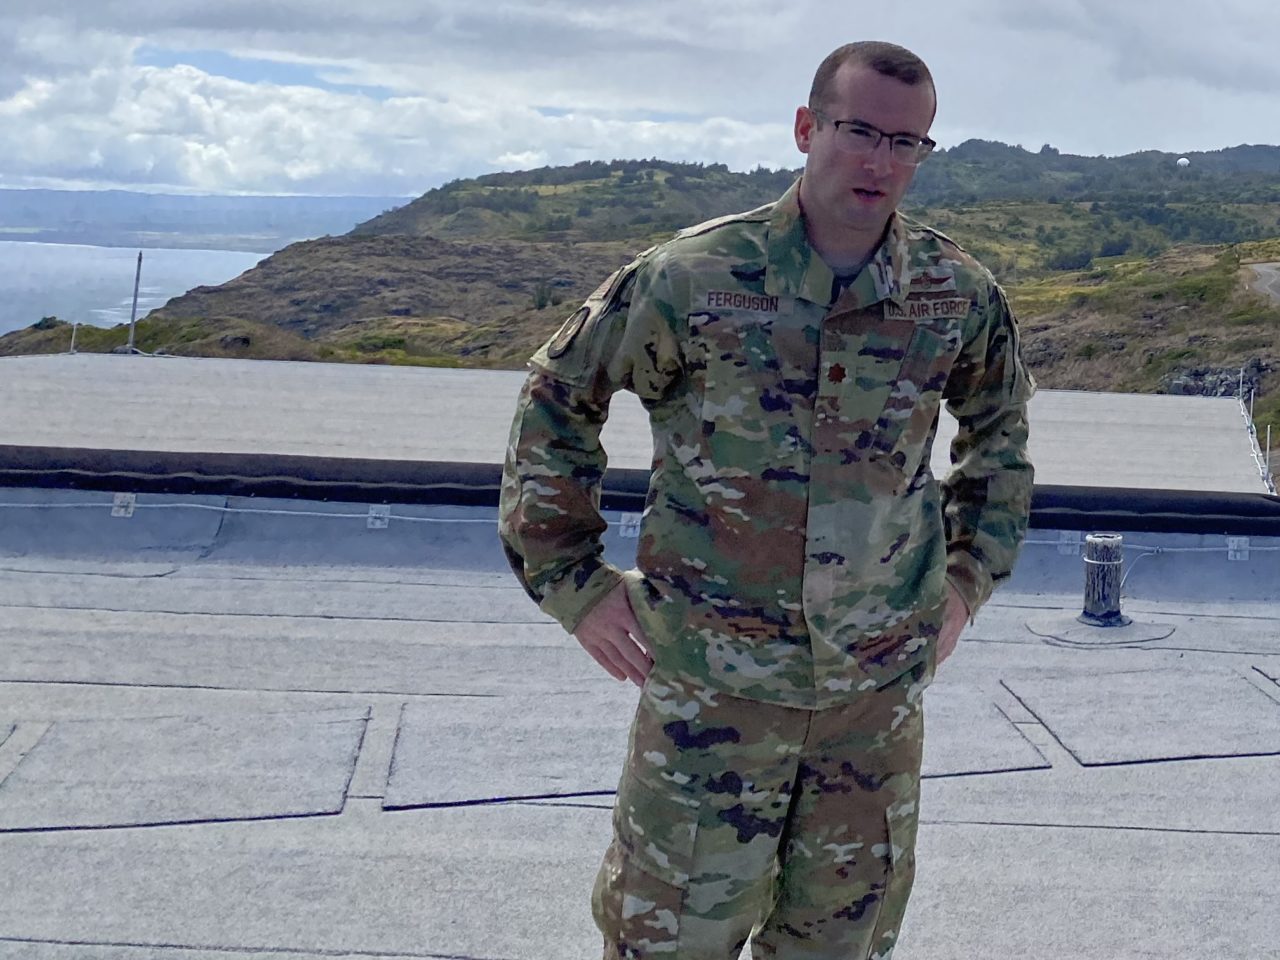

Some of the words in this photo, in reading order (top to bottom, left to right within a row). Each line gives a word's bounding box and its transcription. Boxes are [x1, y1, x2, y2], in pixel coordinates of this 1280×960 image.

[707, 292, 778, 312] FERGUSON
[888, 304, 906, 317] U.S.
[909, 303, 930, 317] AIR
[933, 300, 969, 317] FORCE
